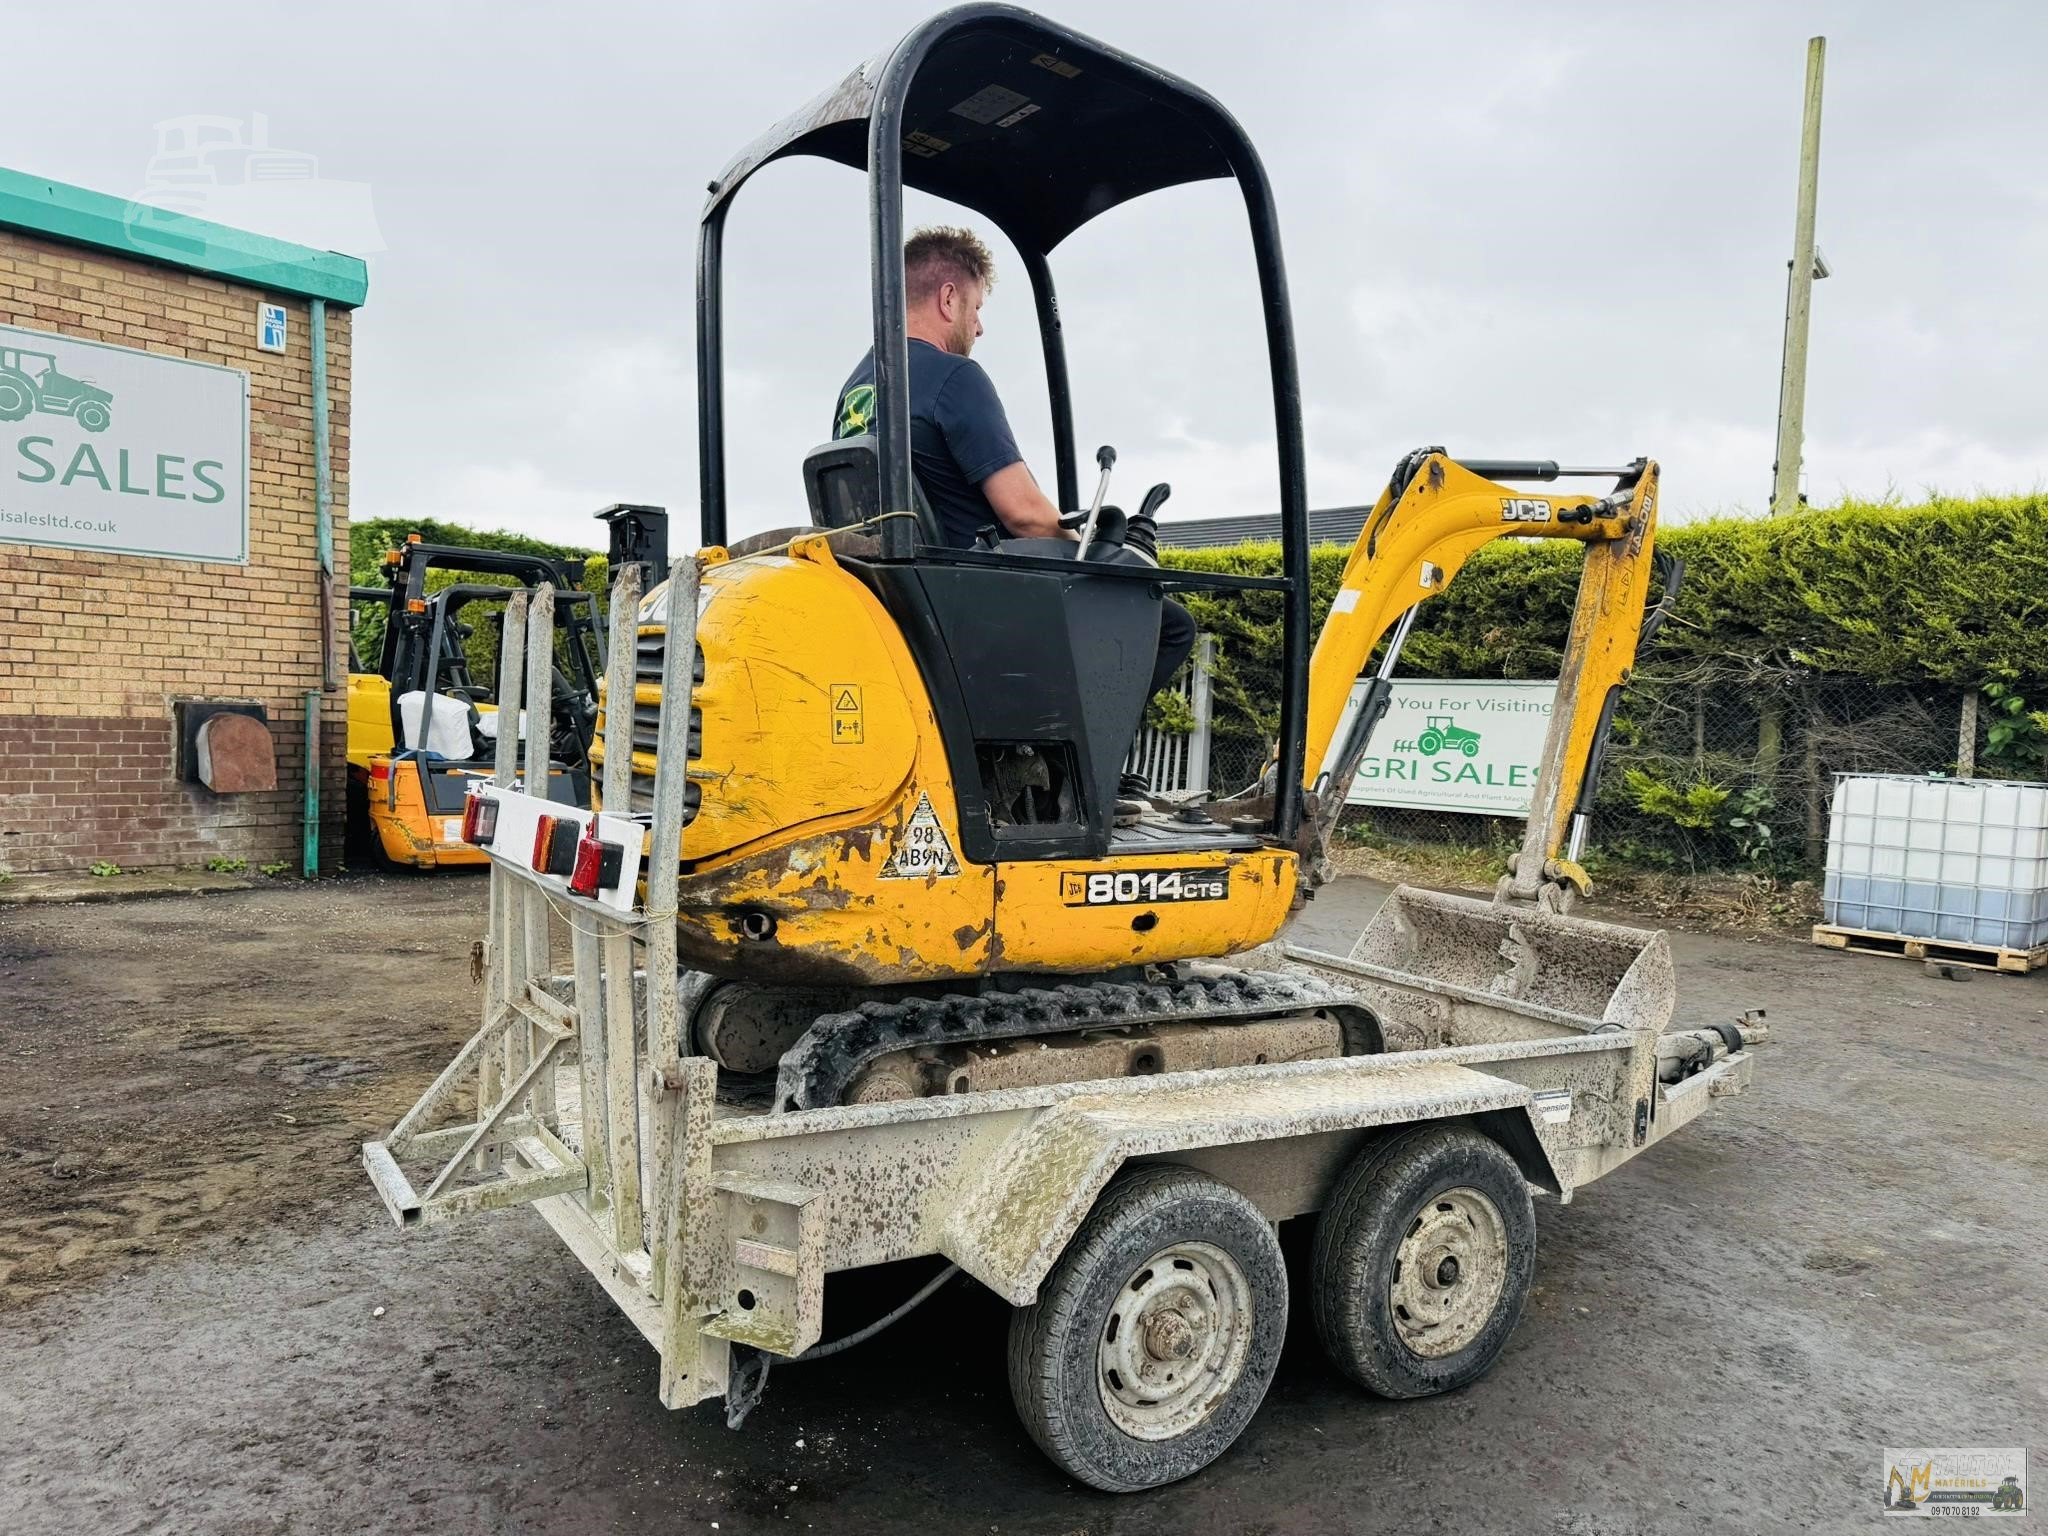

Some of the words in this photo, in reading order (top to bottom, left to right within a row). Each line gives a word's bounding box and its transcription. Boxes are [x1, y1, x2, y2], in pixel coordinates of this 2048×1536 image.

[17, 436, 225, 504] SALES
[1500, 499, 1551, 521] JCB
[1398, 698, 1432, 710] You
[1439, 698, 1473, 711] For
[1476, 699, 1553, 717] Visiting
[913, 826, 934, 844] 98
